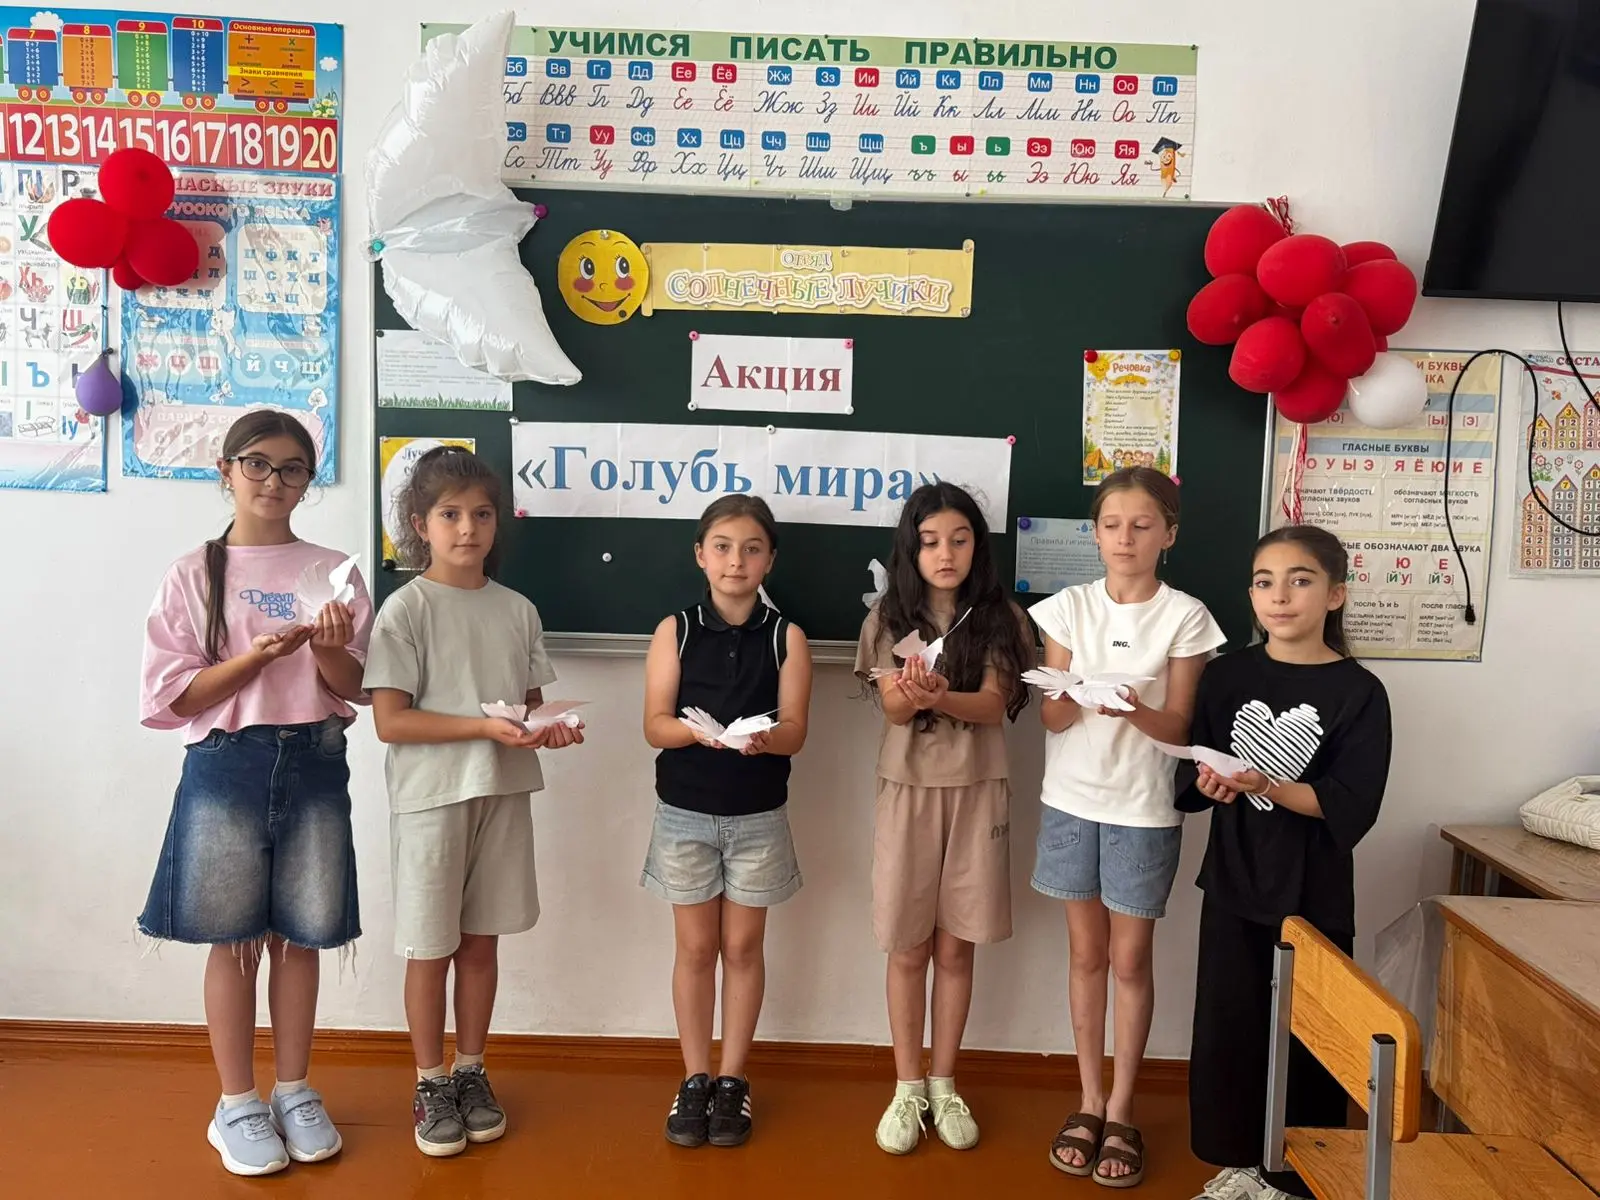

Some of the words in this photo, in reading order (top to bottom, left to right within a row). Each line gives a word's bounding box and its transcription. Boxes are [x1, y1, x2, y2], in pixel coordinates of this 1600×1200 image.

[84, 26, 90, 34] 8
[138, 22, 146, 31] 9
[192, 20, 204, 28] 10
[233, 24, 271, 32] Основные
[273, 26, 310, 34] операции
[29, 30, 35, 38] 7
[548, 30, 690, 57] УЧИМСЯ
[730, 36, 871, 62] ПИСАТЬ
[905, 41, 1118, 69] ПРАВИЛЬНО
[507, 62, 523, 73] Бб
[550, 63, 566, 74] Вв
[593, 64, 606, 76] Гг
[632, 66, 649, 79] Дд
[676, 67, 692, 79] Ее
[717, 68, 732, 80] Ёё
[769, 70, 790, 81] Жж
[822, 72, 835, 82] Зз
[858, 73, 876, 84] Ии
[900, 72, 917, 85] Йй
[941, 75, 956, 86] Кк
[982, 78, 999, 88] Лл
[1030, 78, 1049, 88] Мм
[1079, 80, 1096, 90] Нн
[1117, 81, 1134, 92] Оо
[1156, 82, 1173, 92] Пп
[588, 84, 610, 107] Гг
[627, 86, 654, 118] Дд
[674, 87, 693, 110] Ее
[714, 86, 734, 111] Ёё
[753, 90, 805, 113] Жж
[816, 92, 838, 123] Зз
[853, 93, 880, 116] Ии
[894, 91, 921, 117] Йй
[933, 95, 962, 118] Кк
[973, 97, 1006, 119] Лл
[1016, 98, 1061, 120] Мм
[1071, 99, 1102, 122] Нн
[1113, 100, 1136, 122] Оо
[1146, 100, 1181, 124] Пп
[9, 112, 45, 155] 12
[46, 114, 80, 156] 13
[82, 114, 116, 158] 14
[118, 117, 153, 152] 15
[156, 118, 190, 162] 16
[192, 120, 227, 164] 17
[228, 122, 264, 166] 18
[266, 124, 300, 168] 19
[302, 126, 337, 168] 20
[508, 130, 522, 138] Сс
[552, 128, 565, 139] Тт
[594, 130, 610, 143] Уу
[633, 131, 654, 145] Фф
[682, 133, 697, 144] Хх
[724, 136, 741, 148] Цц
[766, 136, 781, 147] Чч
[808, 137, 830, 148] Шш
[860, 139, 882, 151] Щщ
[920, 142, 927, 151] ъ
[957, 143, 967, 151] ы
[995, 143, 1001, 152] ь
[1030, 143, 1047, 154] Ээ
[1072, 144, 1094, 155] Юю
[1119, 144, 1135, 155] Яя
[504, 145, 525, 168] Сс
[536, 147, 581, 170] Тт
[591, 149, 613, 180] Уу
[628, 151, 658, 181] Фф
[670, 152, 708, 175] Хх
[717, 153, 748, 181] Цц
[764, 154, 787, 177] Чч
[799, 156, 838, 179] Шш
[850, 157, 893, 185] Щщ
[908, 170, 937, 181] ъъ
[953, 170, 968, 182] ы
[987, 170, 1006, 182] ьь
[1027, 161, 1049, 184] Ээ
[1063, 162, 1100, 185] Юю
[1112, 164, 1140, 185] Яя
[62, 170, 80, 196] Р
[264, 180, 333, 196] ЗВУКИ
[671, 275, 830, 303] СОЛНЕЧНЫЕ
[840, 277, 946, 305] ЛУЧИКИ
[20, 308, 36, 330] Ч
[701, 354, 841, 396] Акция
[1112, 363, 1151, 373] Речовка
[1342, 443, 1391, 452] ГЛАСНЫЕ
[1395, 444, 1429, 453] БУКВЫ
[1307, 458, 1317, 469] О
[1326, 459, 1335, 470] У
[1343, 459, 1356, 470] Ы
[1364, 460, 1374, 470] Э
[1395, 461, 1404, 471] Я
[1415, 459, 1424, 472] Ё
[1432, 461, 1445, 472] Ю
[1453, 462, 1462, 473] И
[1473, 463, 1482, 473] Е
[517, 446, 752, 504] «Голубь
[1342, 542, 1360, 550] РЫЕ
[1364, 543, 1428, 551] ОБОЗНАЧАЮТ
[1431, 544, 1449, 552] ДВА
[1354, 554, 1363, 567] Ё
[1396, 558, 1410, 568] Ю
[1439, 559, 1448, 569] Е
[240, 590, 296, 605] Dream
[258, 603, 296, 620] Big
